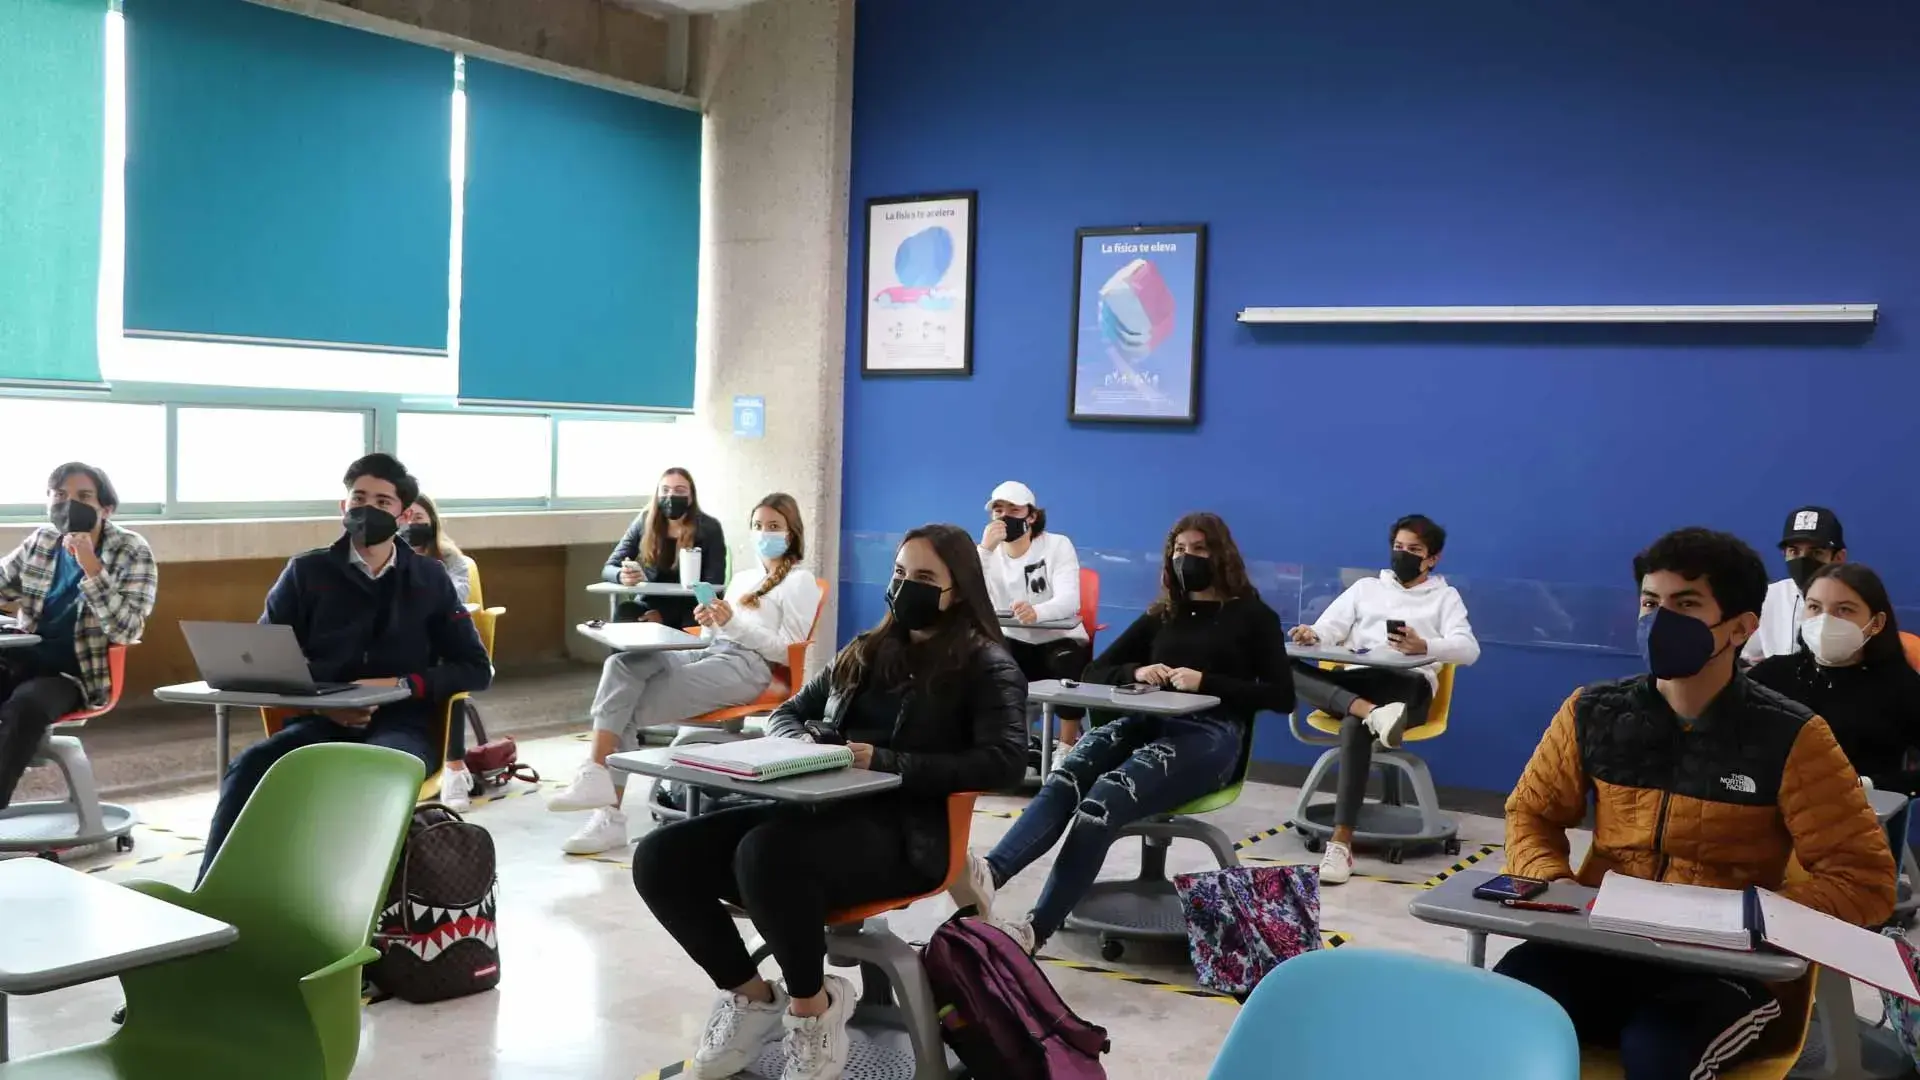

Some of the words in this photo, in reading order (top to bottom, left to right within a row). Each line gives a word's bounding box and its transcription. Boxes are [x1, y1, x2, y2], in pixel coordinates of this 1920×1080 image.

[1102, 244, 1112, 253] La
[1139, 242, 1149, 253] te
[1150, 242, 1176, 252] eleva
[1720, 776, 1744, 786] NORTH
[1726, 783, 1744, 791] FACE
